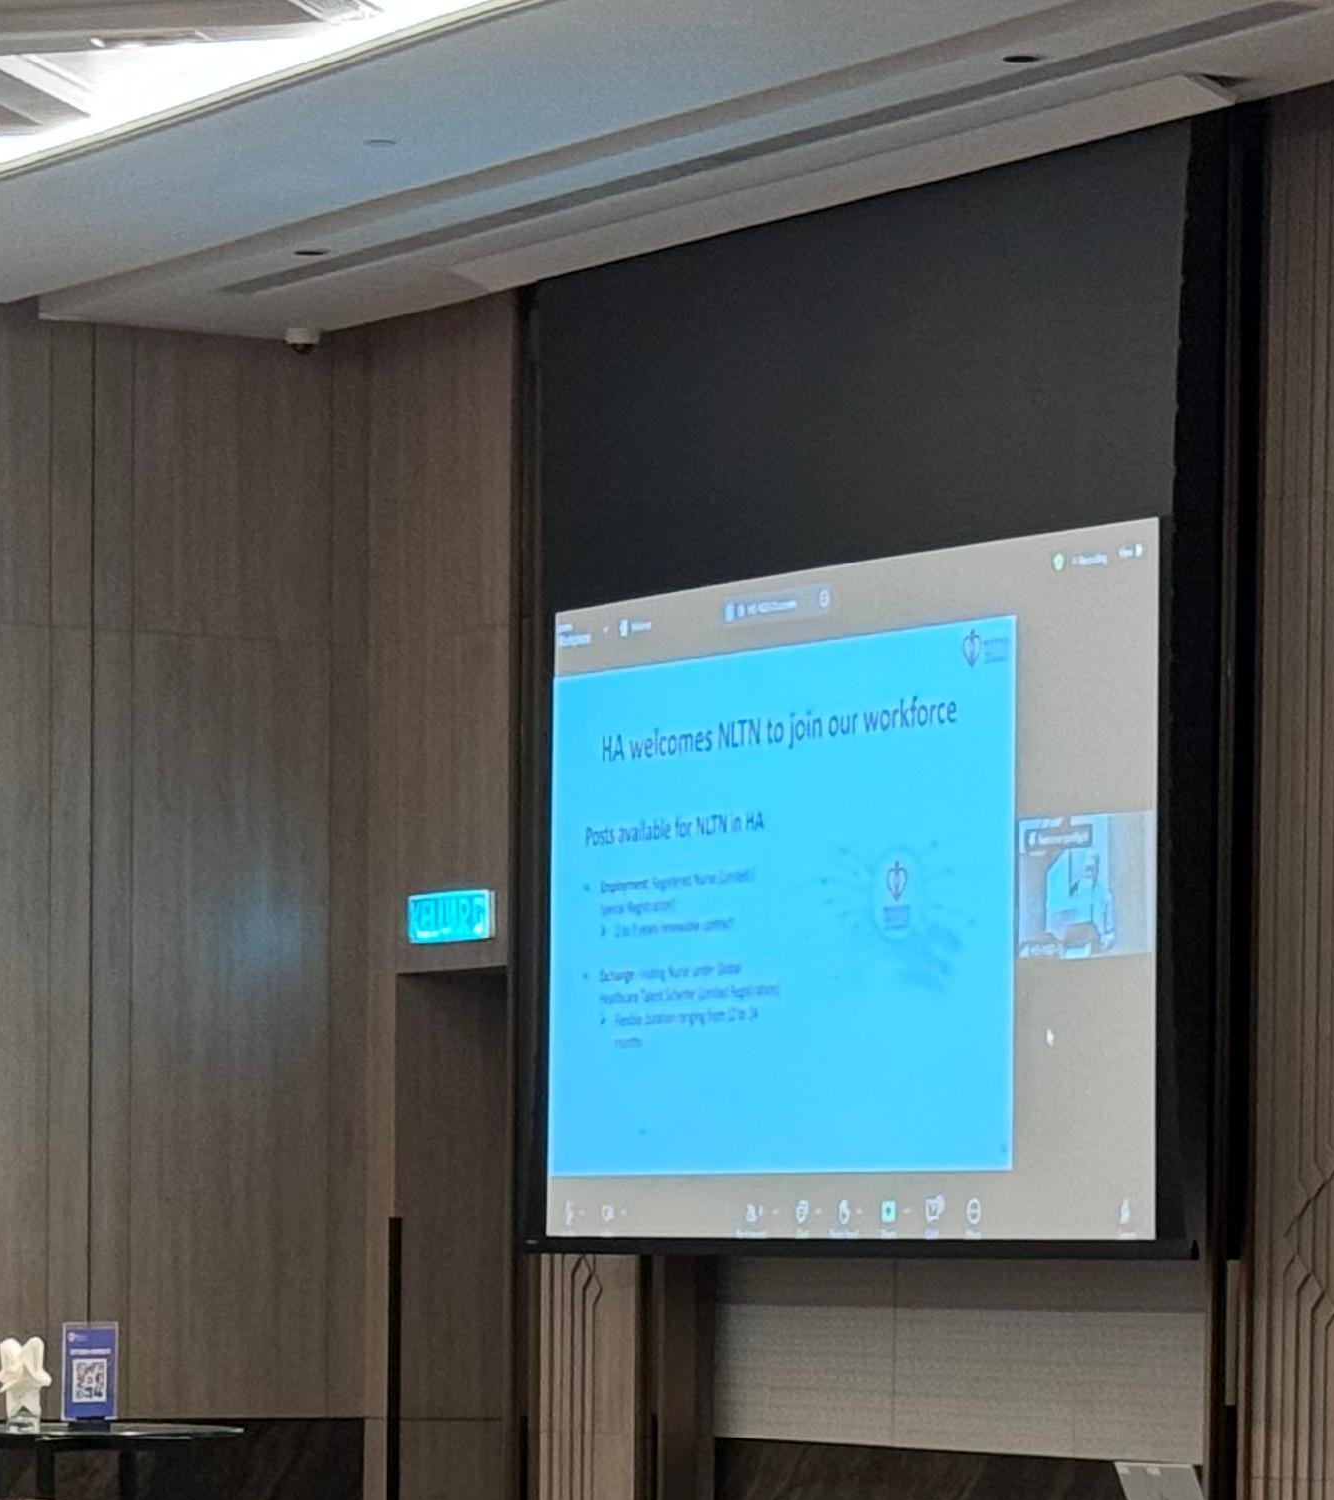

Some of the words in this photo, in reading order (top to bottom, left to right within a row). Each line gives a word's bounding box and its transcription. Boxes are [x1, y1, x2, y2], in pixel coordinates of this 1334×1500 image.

[601, 734, 625, 762] HA
[629, 727, 713, 759] welcomes
[717, 718, 762, 750] NLTN
[766, 717, 785, 745] to
[787, 709, 823, 750] join
[827, 712, 859, 737] our
[864, 695, 958, 733] workforce
[585, 826, 615, 847] Posts
[618, 818, 671, 843] available
[675, 816, 692, 838] for
[696, 812, 728, 836] NLTN
[730, 811, 742, 833] in
[745, 811, 764, 831] HA
